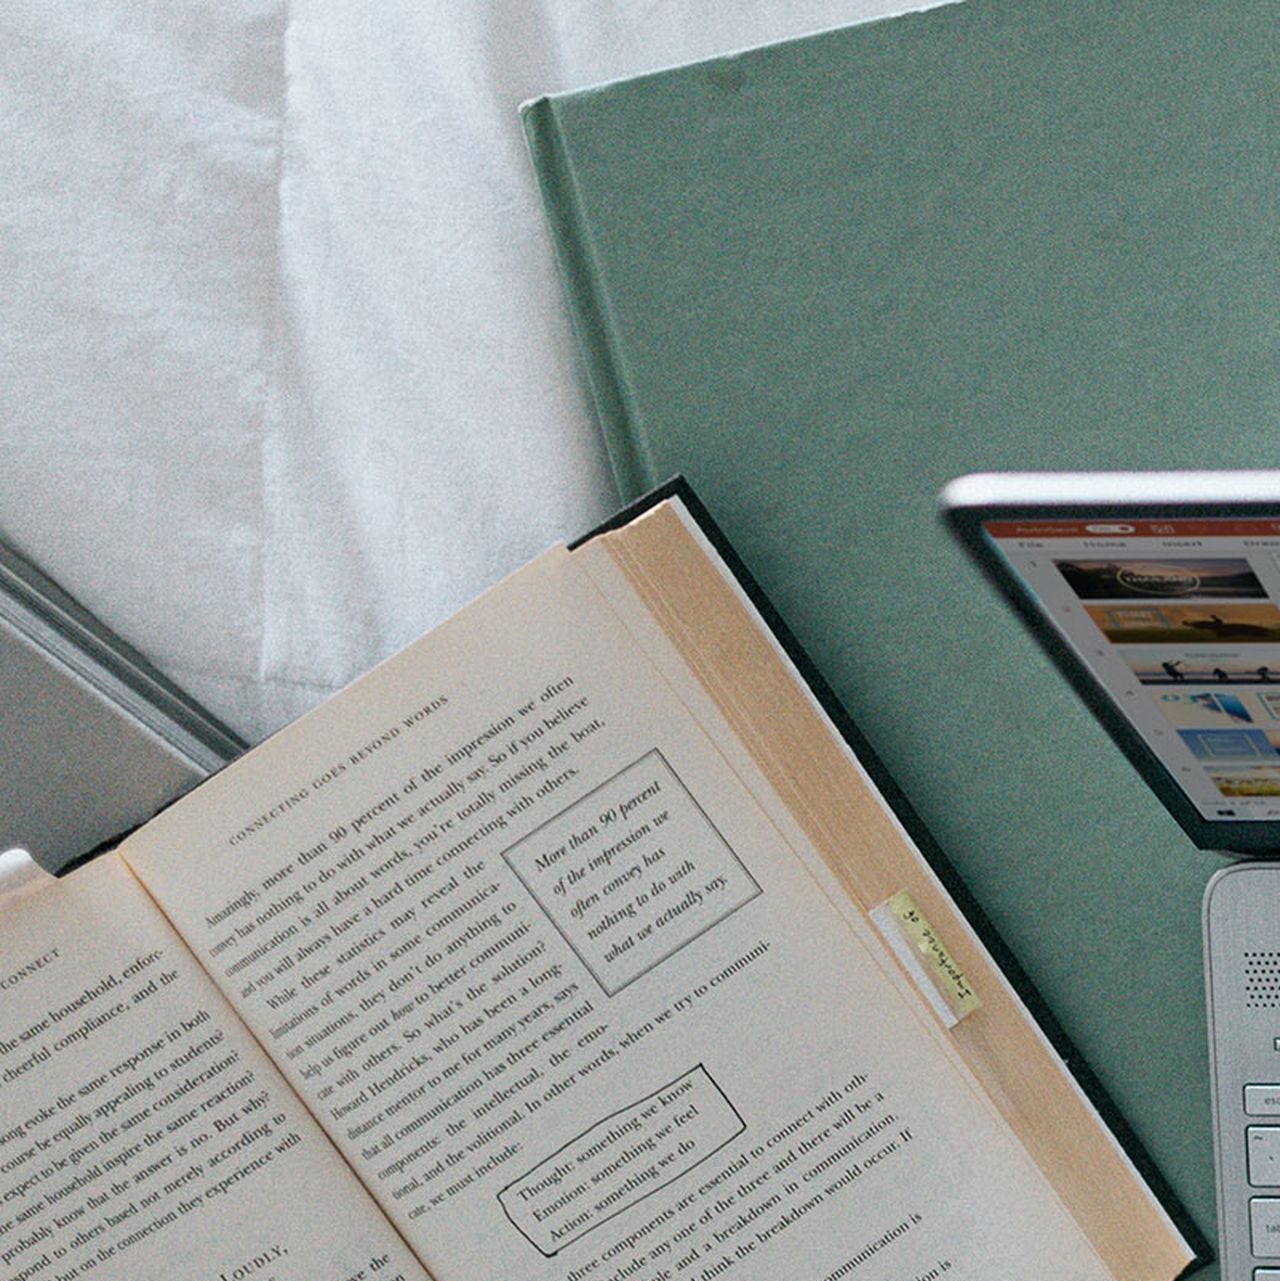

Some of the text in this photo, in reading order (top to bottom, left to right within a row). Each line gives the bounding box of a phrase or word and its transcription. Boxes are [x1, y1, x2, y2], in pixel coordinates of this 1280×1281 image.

[229, 696, 448, 846] CONNECTING GOES BEYOND WORDS
[534, 780, 661, 872] More than 90 percent
[552, 810, 668, 896] of the impression we
[569, 848, 666, 918] often convey has
[586, 859, 696, 940] nothing to do with
[603, 876, 727, 963] what we actually say.
[518, 1080, 693, 1201] Thought: something we know
[532, 1103, 699, 1222] Emotion: something we feel
[550, 1139, 696, 1242] Action: something we do
